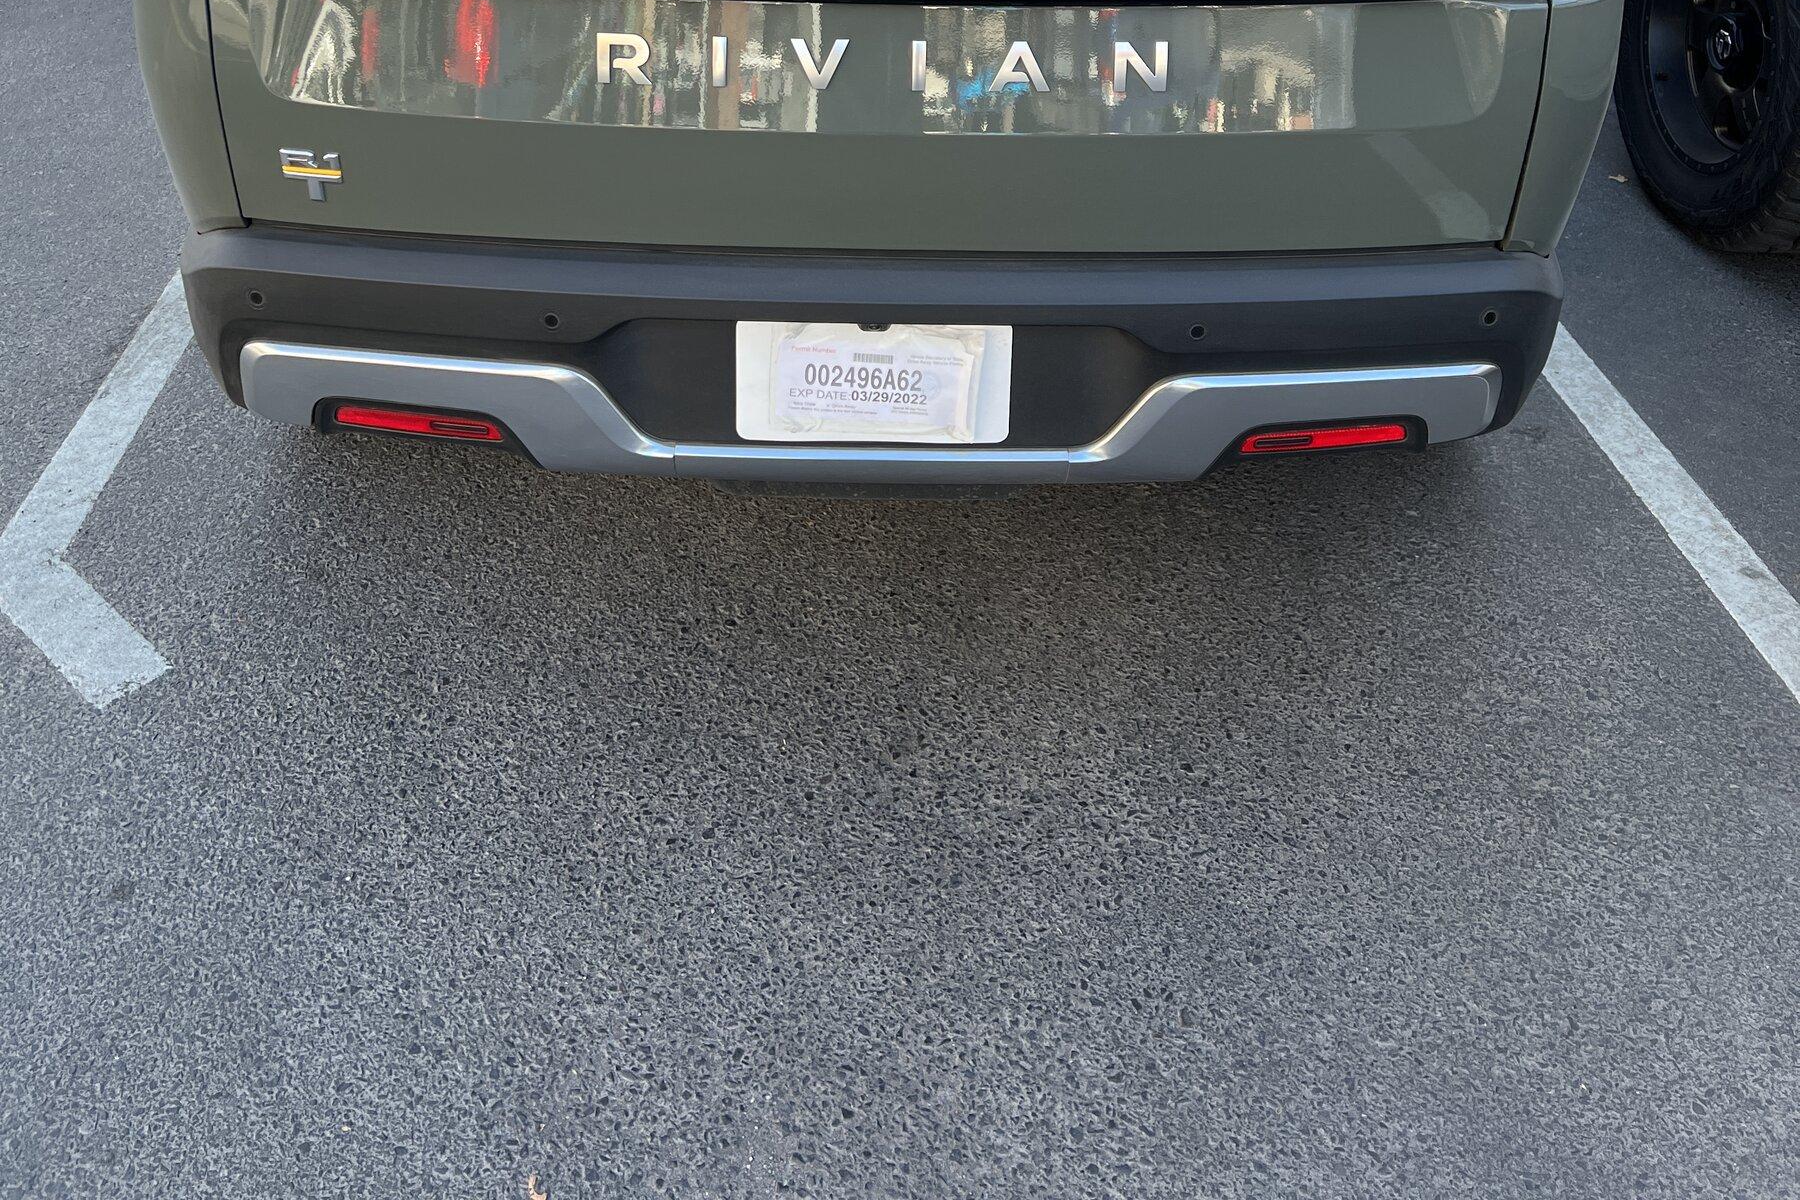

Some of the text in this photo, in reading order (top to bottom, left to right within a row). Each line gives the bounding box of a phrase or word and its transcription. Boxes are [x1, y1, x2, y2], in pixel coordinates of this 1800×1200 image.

[596, 32, 1169, 92] RIVIAN
[804, 363, 923, 392] 002496A62
[789, 387, 814, 398] EXP
